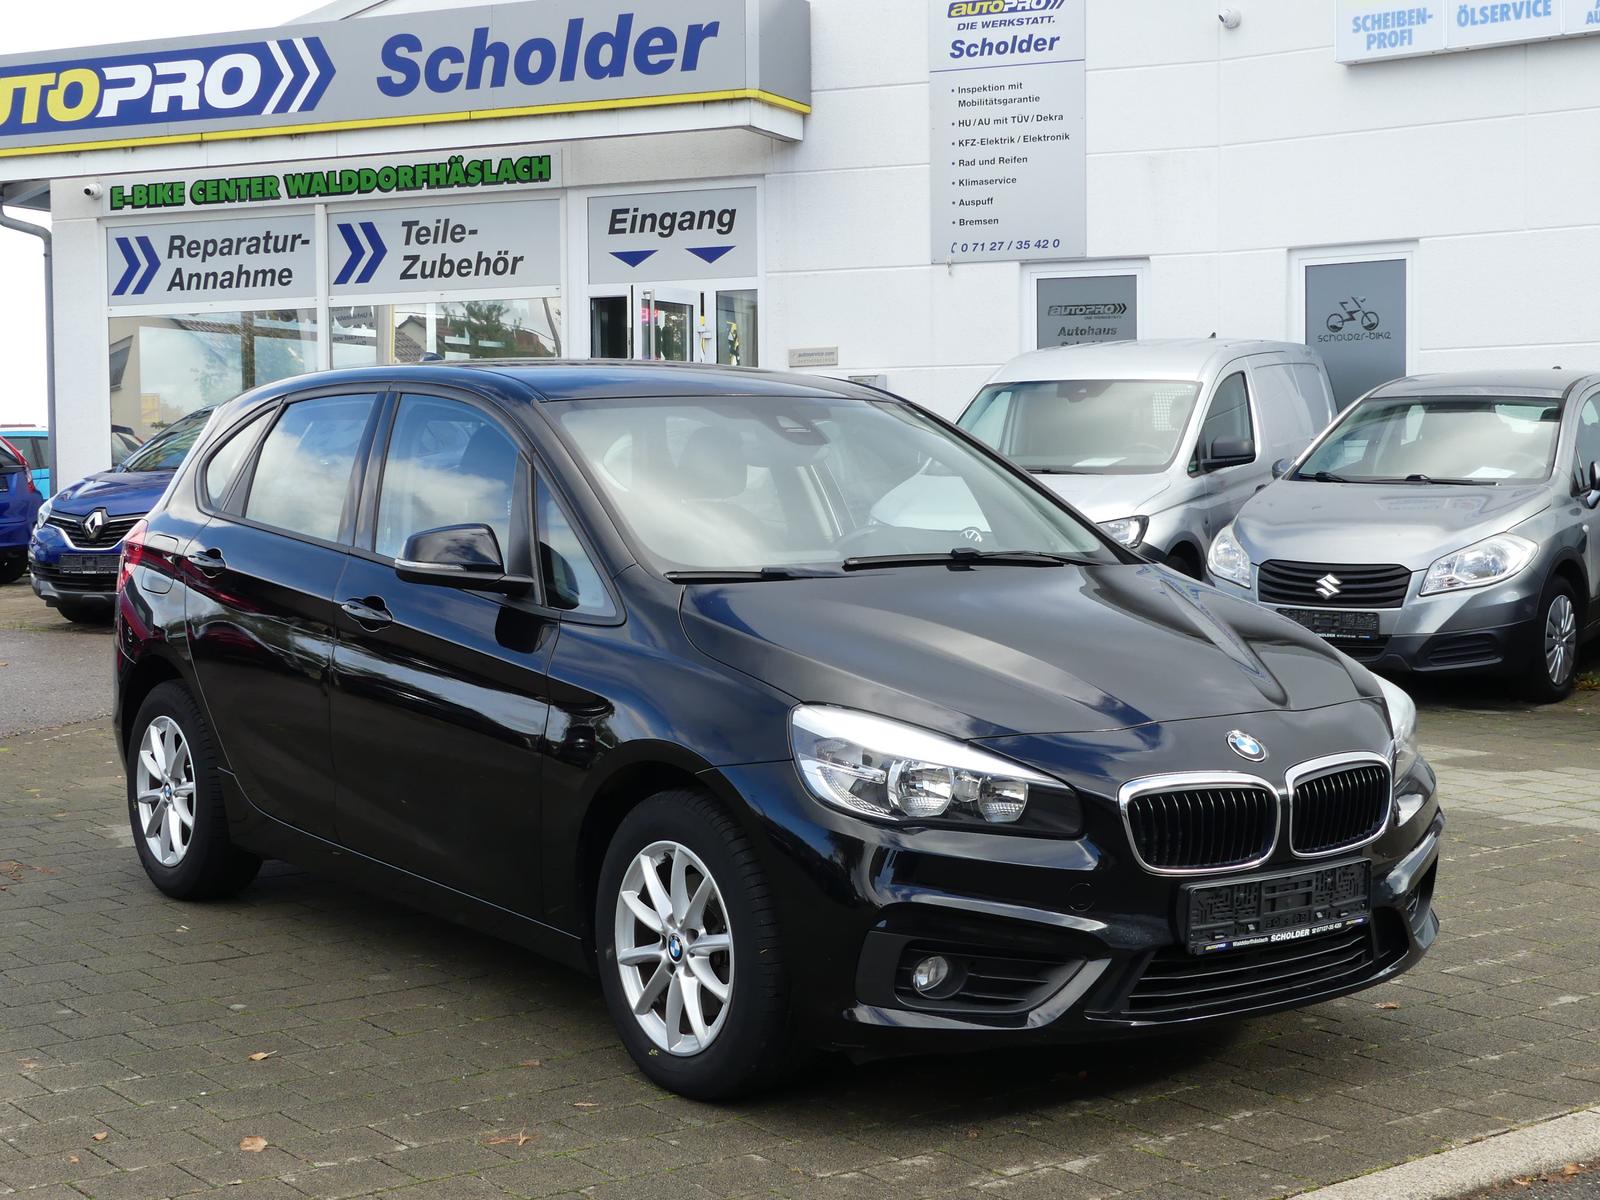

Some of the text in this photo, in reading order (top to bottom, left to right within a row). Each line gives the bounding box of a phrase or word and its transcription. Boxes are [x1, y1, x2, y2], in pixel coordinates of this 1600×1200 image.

[1352, 8, 1433, 34] SCHEIBEN-
[1457, 0, 1552, 27] ÖLSERVICE
[957, 15, 1055, 31] DIE WERKSTATT.
[949, 33, 1061, 59] Scholder
[1366, 29, 1413, 50] PROFI
[376, 13, 721, 98] Scholder
[958, 82, 1023, 95] Inspektion mit
[958, 95, 1040, 107] Mobilitätsgarantie
[993, 117, 1008, 125] mit
[958, 137, 1015, 147] KFZ-Elektrik
[1023, 132, 1070, 143] Elektronik
[958, 156, 1028, 167] Rad und Reifen
[110, 155, 552, 210] E-BIKE CENTER WALDDORFHÄSLACH
[959, 176, 1017, 187] Klimaservice
[958, 197, 994, 208] Auspuff
[608, 207, 737, 239] Eingang
[959, 218, 999, 226] Bremsen
[401, 218, 479, 246] Teile-
[167, 230, 311, 263] Reparatur-
[400, 250, 525, 280] Zubehör
[166, 264, 294, 292] Annahme
[1057, 326, 1119, 336] Autohaus
[1270, 928, 1310, 942] SCHOLDER
